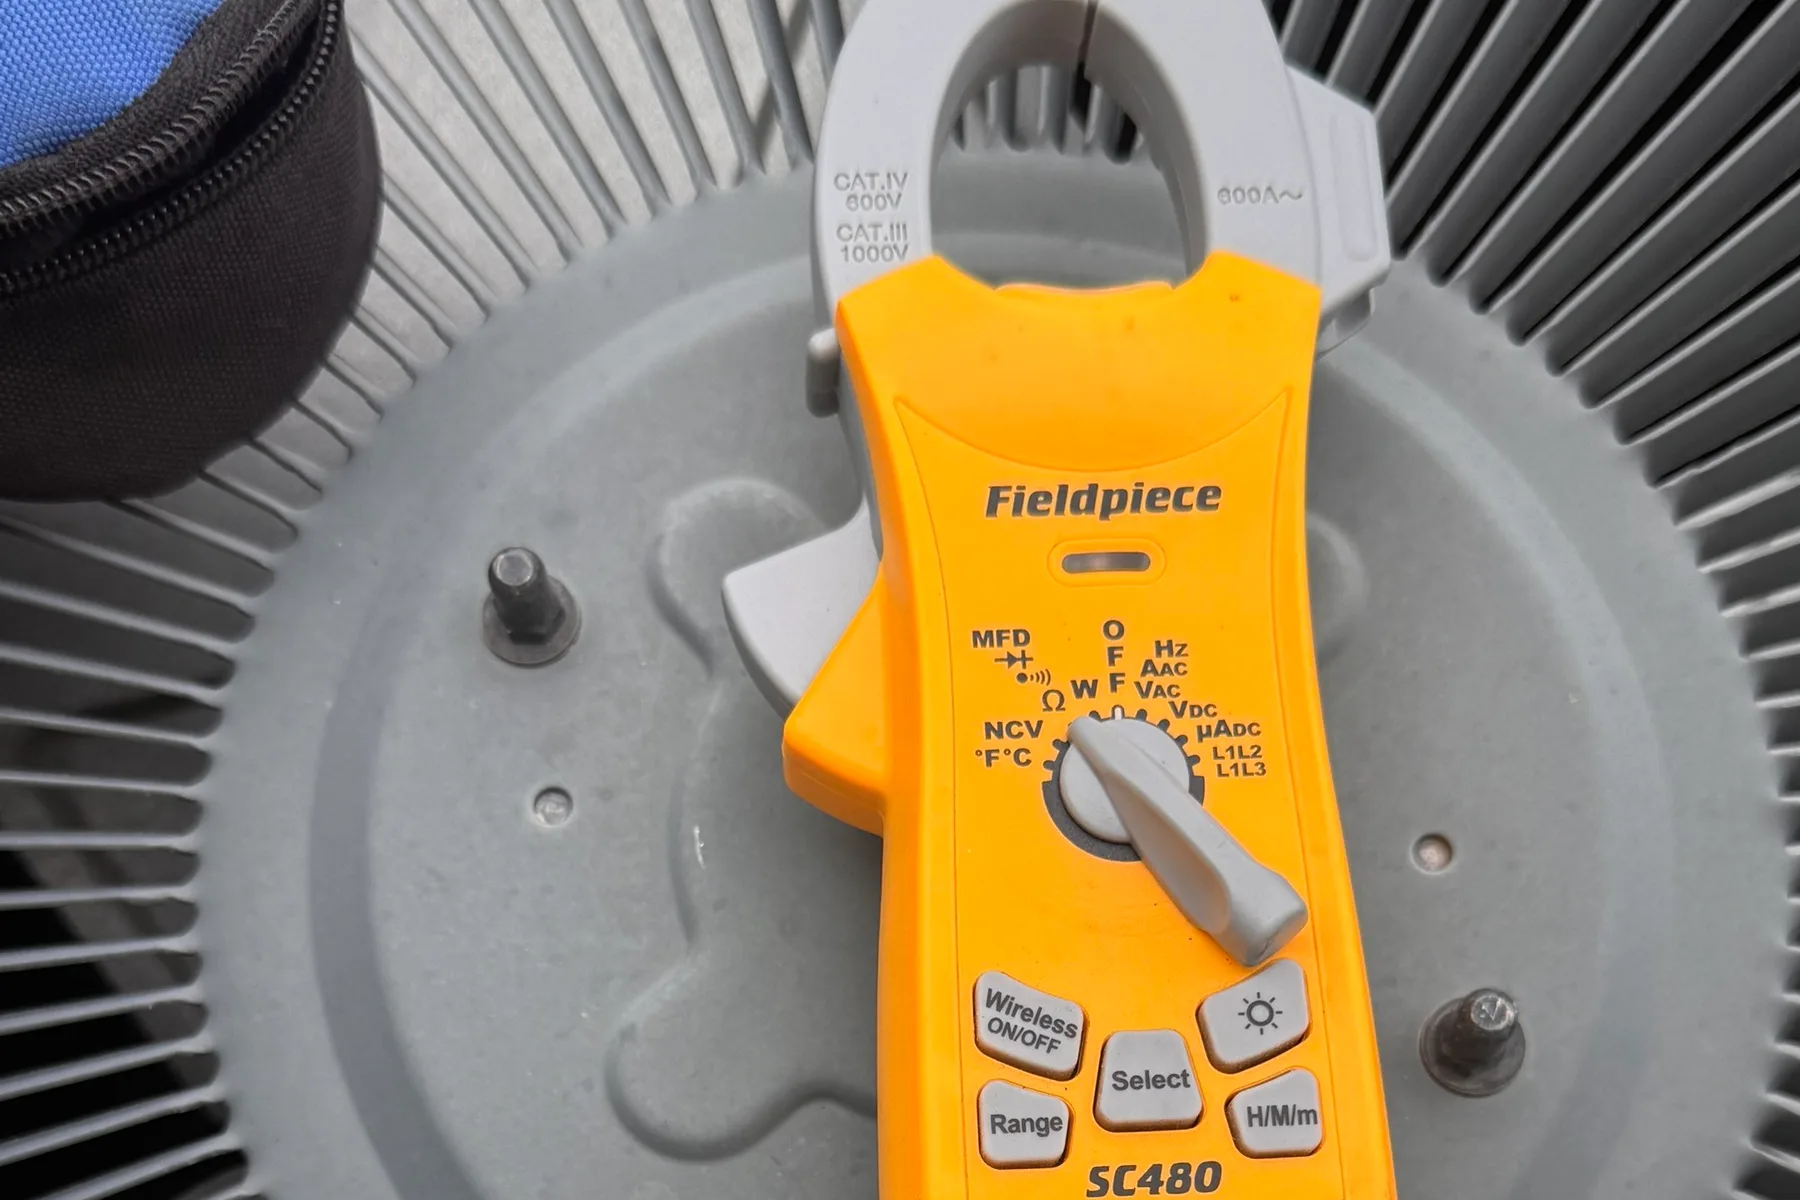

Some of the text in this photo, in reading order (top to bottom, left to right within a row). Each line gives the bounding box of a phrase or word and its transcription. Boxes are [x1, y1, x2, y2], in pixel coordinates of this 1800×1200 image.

[841, 244, 909, 263] 1000V
[985, 482, 1222, 521] Fieldpiece
[972, 629, 1031, 649] MFD
[1154, 639, 1189, 659] Hz
[1070, 679, 1098, 699] W
[984, 720, 1043, 740] NCV
[1212, 745, 1262, 761] L1L2
[1217, 762, 1267, 778] L1L3
[985, 988, 1078, 1039] Wireless
[987, 1017, 1061, 1055] ON/OFF
[1112, 1068, 1190, 1092] Select
[990, 1114, 1063, 1137] Range
[1247, 1104, 1318, 1128] H/M/m
[1086, 1161, 1222, 1198] SC480
